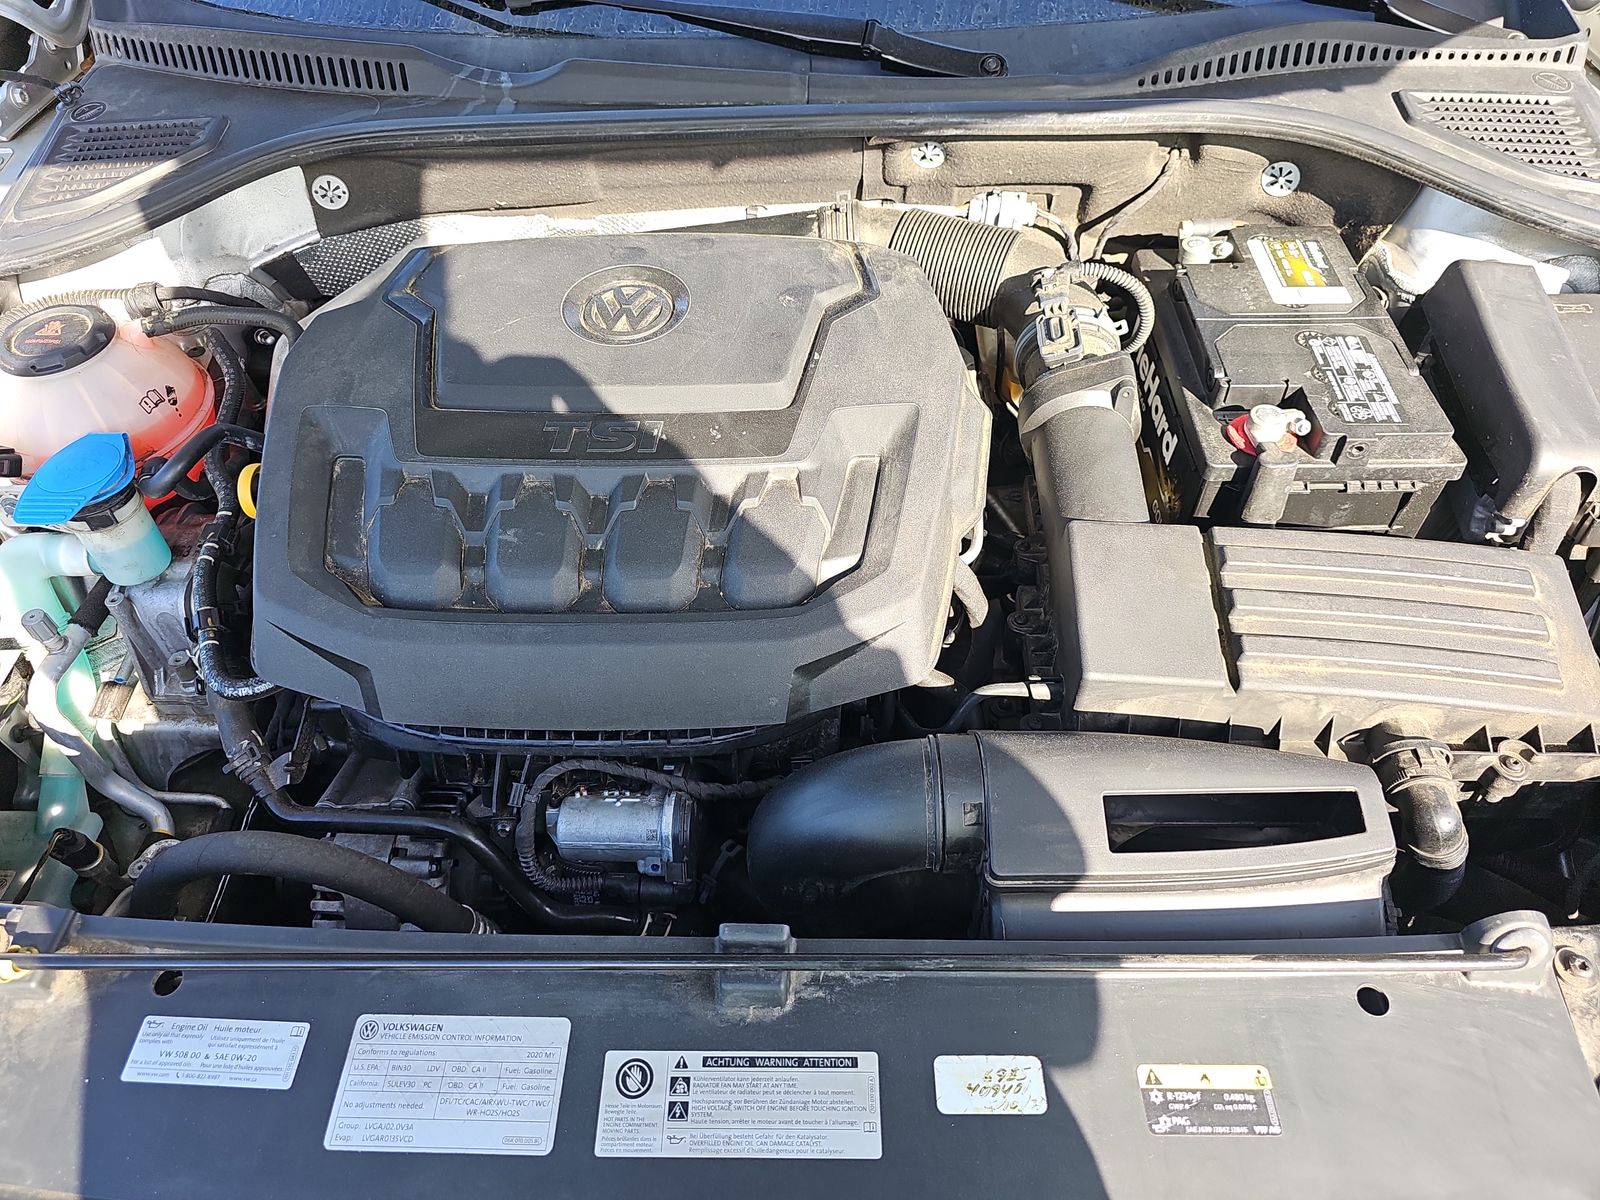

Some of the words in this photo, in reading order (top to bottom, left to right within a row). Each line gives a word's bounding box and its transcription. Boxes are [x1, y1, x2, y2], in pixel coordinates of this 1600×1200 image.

[543, 420, 664, 453] TSI
[172, 1023, 196, 1032] Engine
[382, 1023, 444, 1031] VOLKSWAGEN
[231, 1054, 257, 1062] 0W-20
[706, 1058, 749, 1066] ACHTUNG
[755, 1058, 798, 1066] WARNING
[803, 1058, 852, 1067] ATTENTION
[355, 1101, 396, 1110] adjustments
[339, 1122, 361, 1130] Group:
